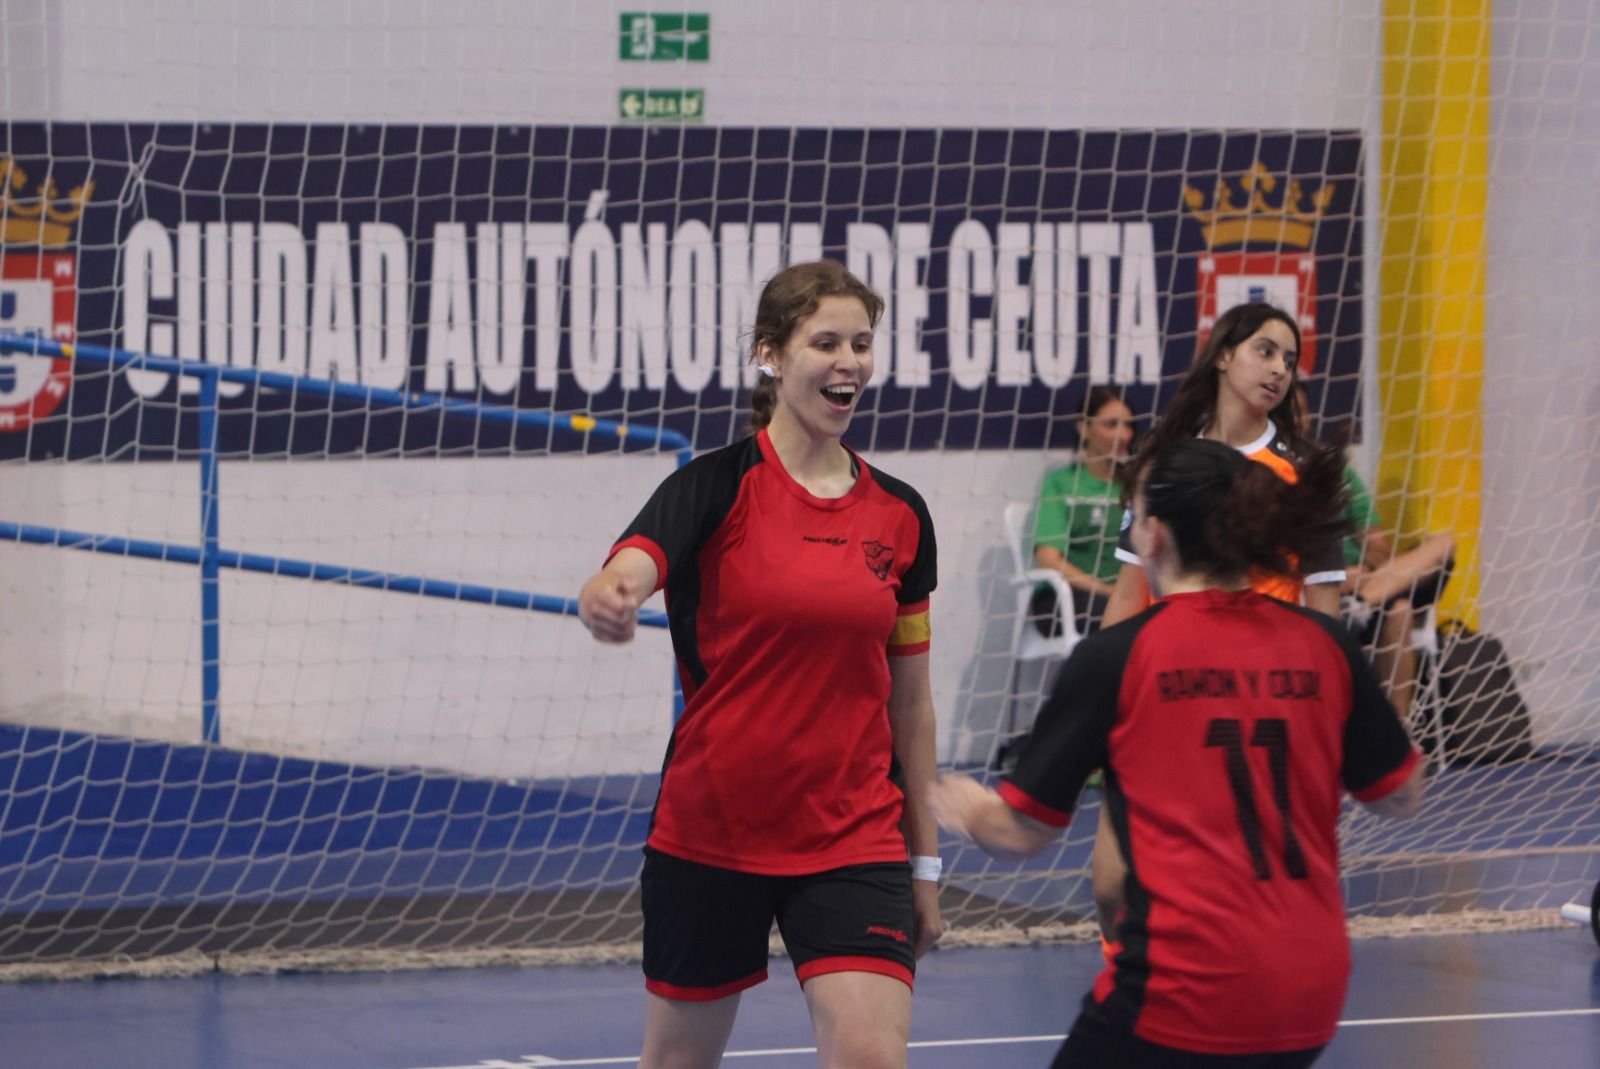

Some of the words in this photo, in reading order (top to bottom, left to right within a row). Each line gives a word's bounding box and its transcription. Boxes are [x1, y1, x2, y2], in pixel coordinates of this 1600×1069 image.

[123, 219, 409, 398] CIUDAD
[424, 189, 823, 394] AUTÓNOM
[845, 221, 932, 388] DE
[947, 218, 1162, 391] CEUTA
[1243, 669, 1260, 698] Y
[1204, 717, 1309, 881] 11
